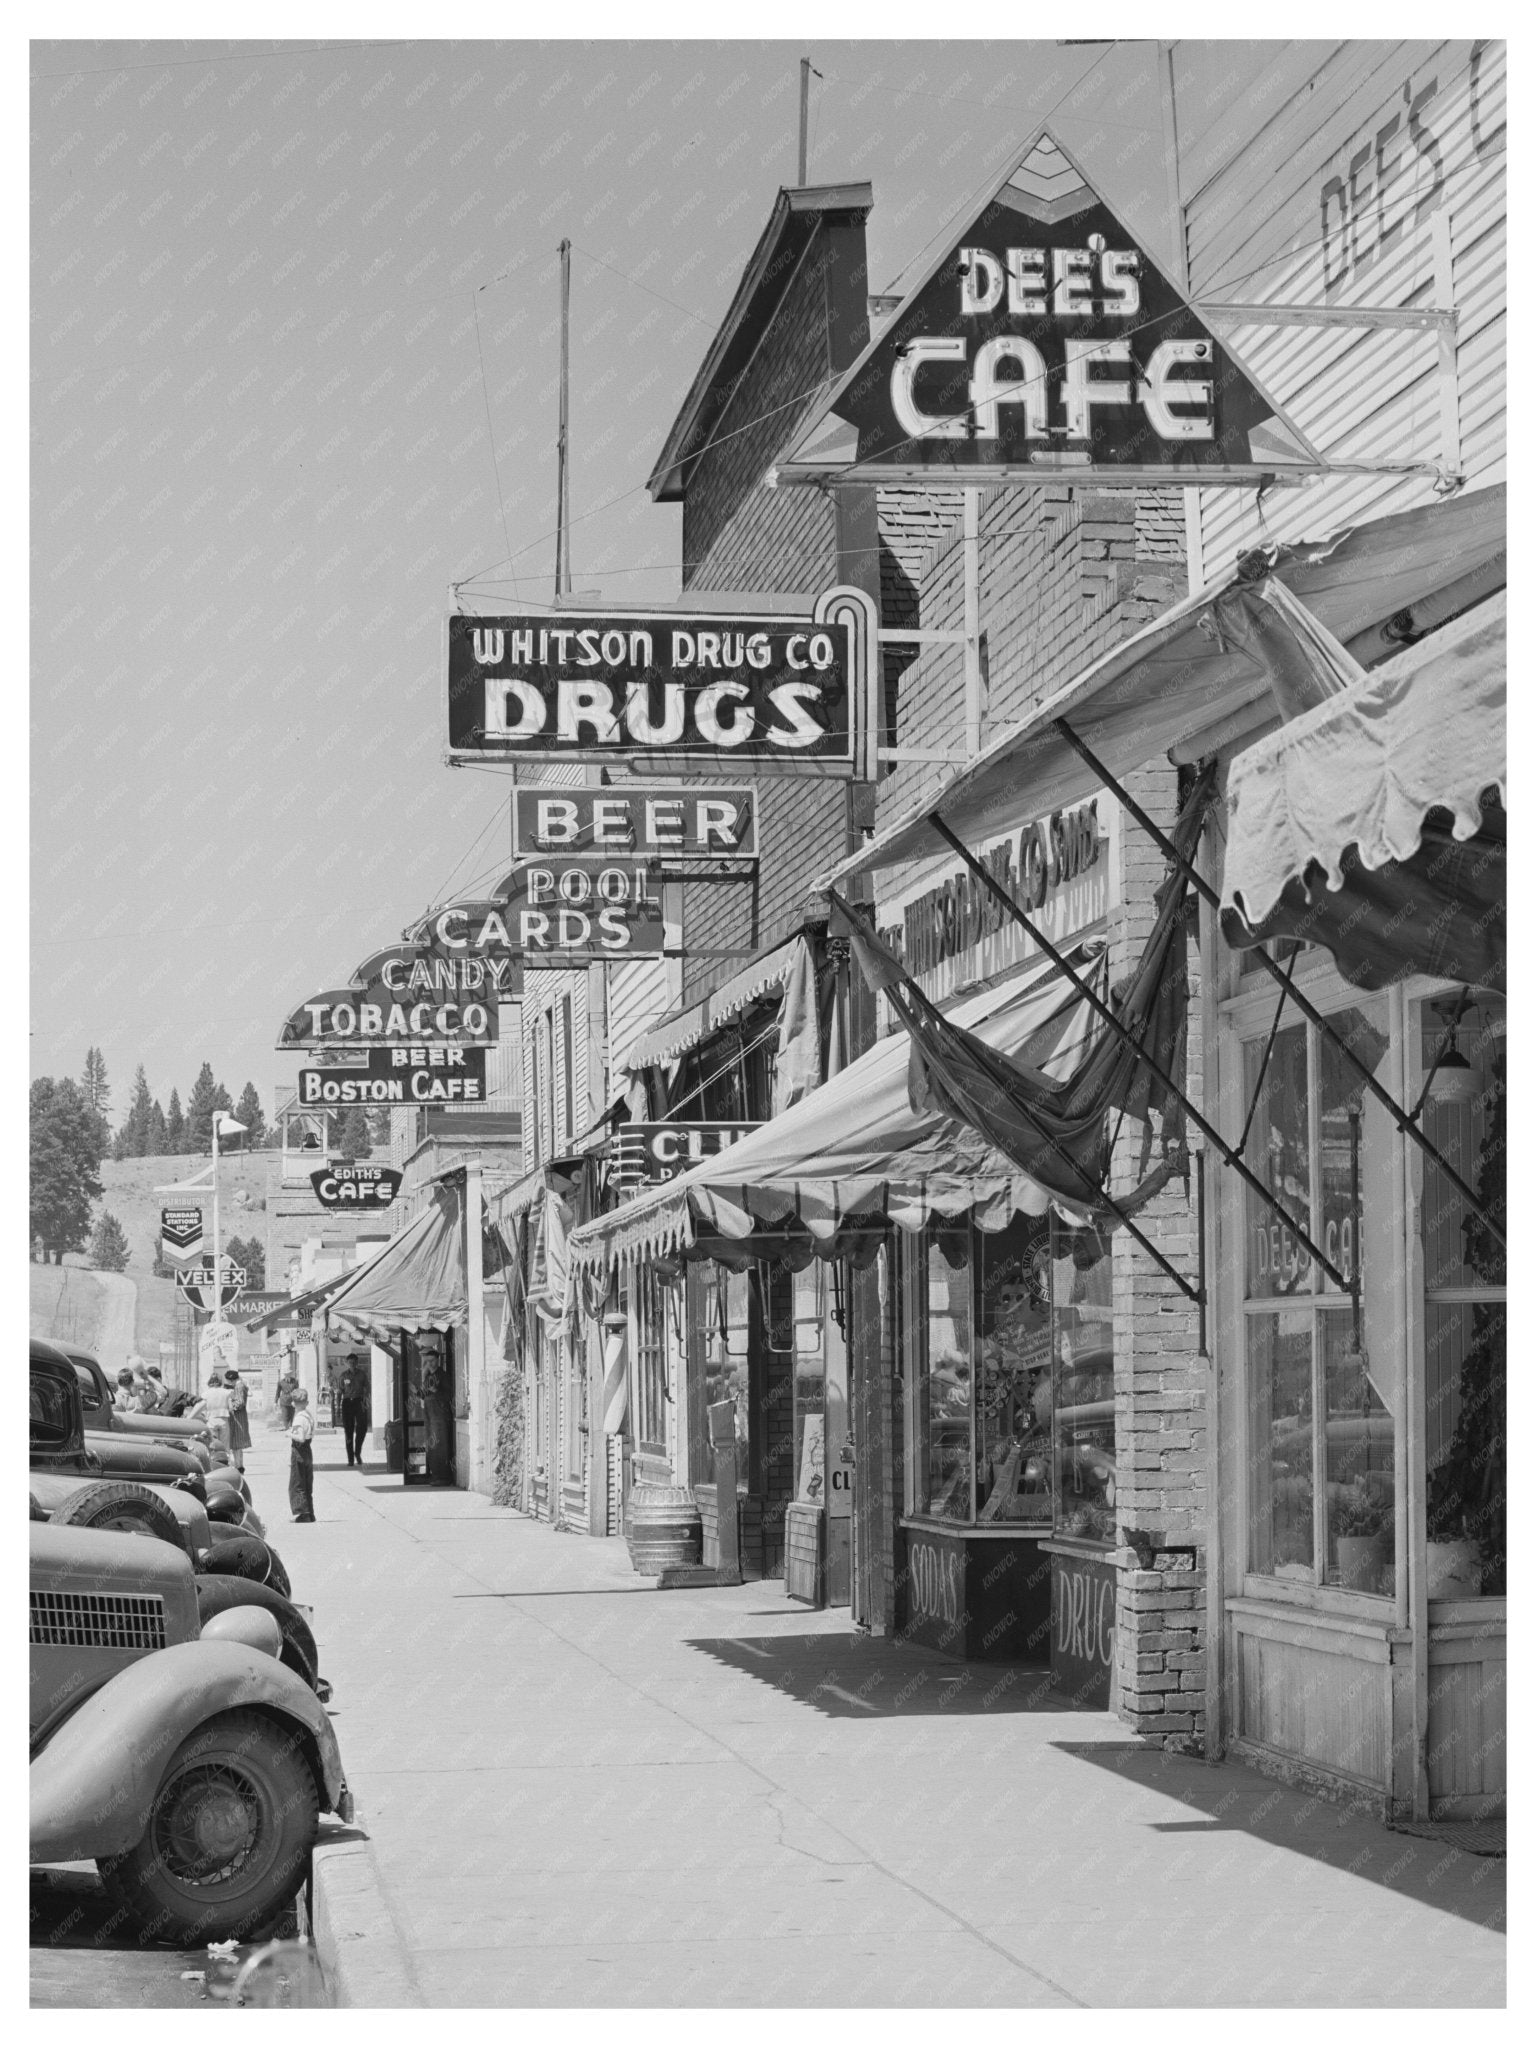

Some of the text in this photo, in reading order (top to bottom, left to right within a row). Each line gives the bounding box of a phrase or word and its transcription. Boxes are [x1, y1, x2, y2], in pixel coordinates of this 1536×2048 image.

[959, 232, 1140, 316] DEE'S
[890, 336, 1215, 441] CAFE
[473, 629, 835, 670] WHITSON DRUG CO
[484, 678, 826, 748] DRUGS
[536, 799, 740, 845] BEER
[527, 868, 660, 904] POOL
[436, 906, 632, 949] CARDS
[381, 958, 510, 990] CANDY
[304, 1003, 489, 1036] TOBACCO
[391, 1049, 467, 1067] BEER
[305, 1070, 480, 1102] BOSTON CAFE
[318, 1179, 393, 1200] CAFE
[333, 1168, 383, 1181] EDITH'S
[158, 1197, 206, 1206] DISTRIBUTOR
[177, 1271, 244, 1285] VELEX
[911, 1543, 958, 1625] SODAS
